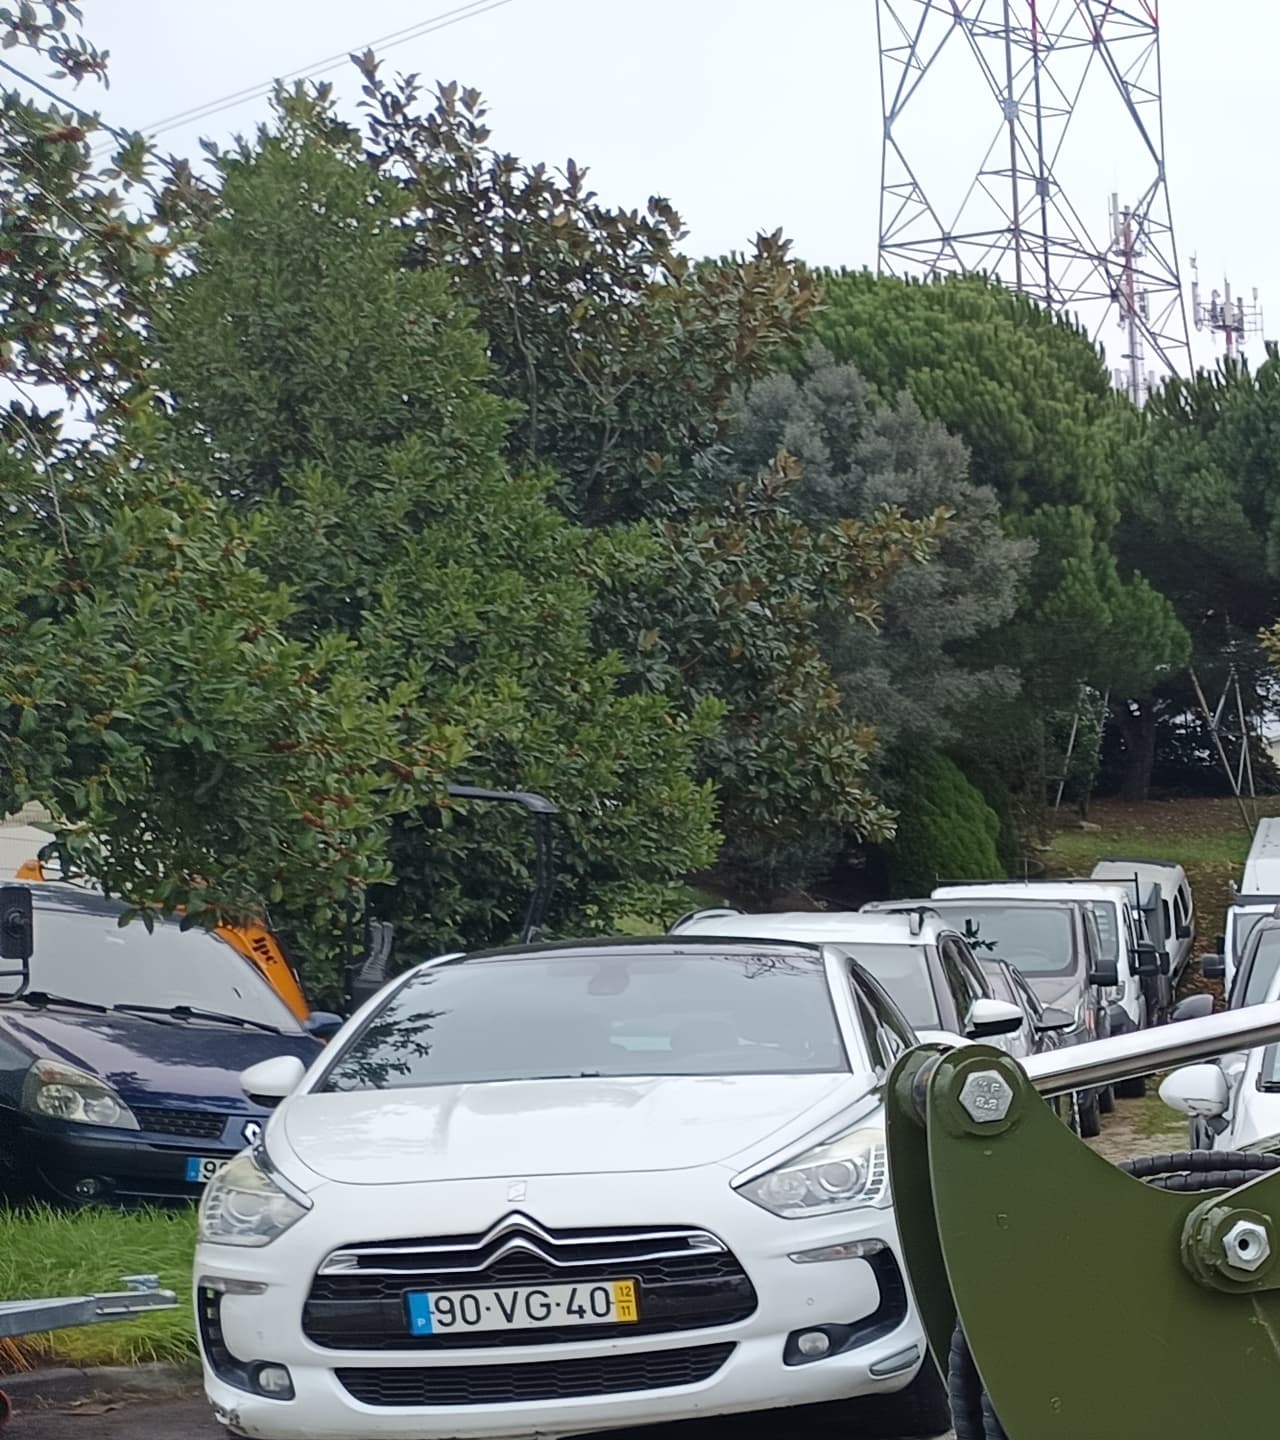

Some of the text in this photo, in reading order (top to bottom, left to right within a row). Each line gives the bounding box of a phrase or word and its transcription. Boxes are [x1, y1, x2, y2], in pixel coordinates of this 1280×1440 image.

[619, 1286, 633, 1297] 12
[621, 1305, 631, 1317] 11
[417, 1318, 426, 1328] P
